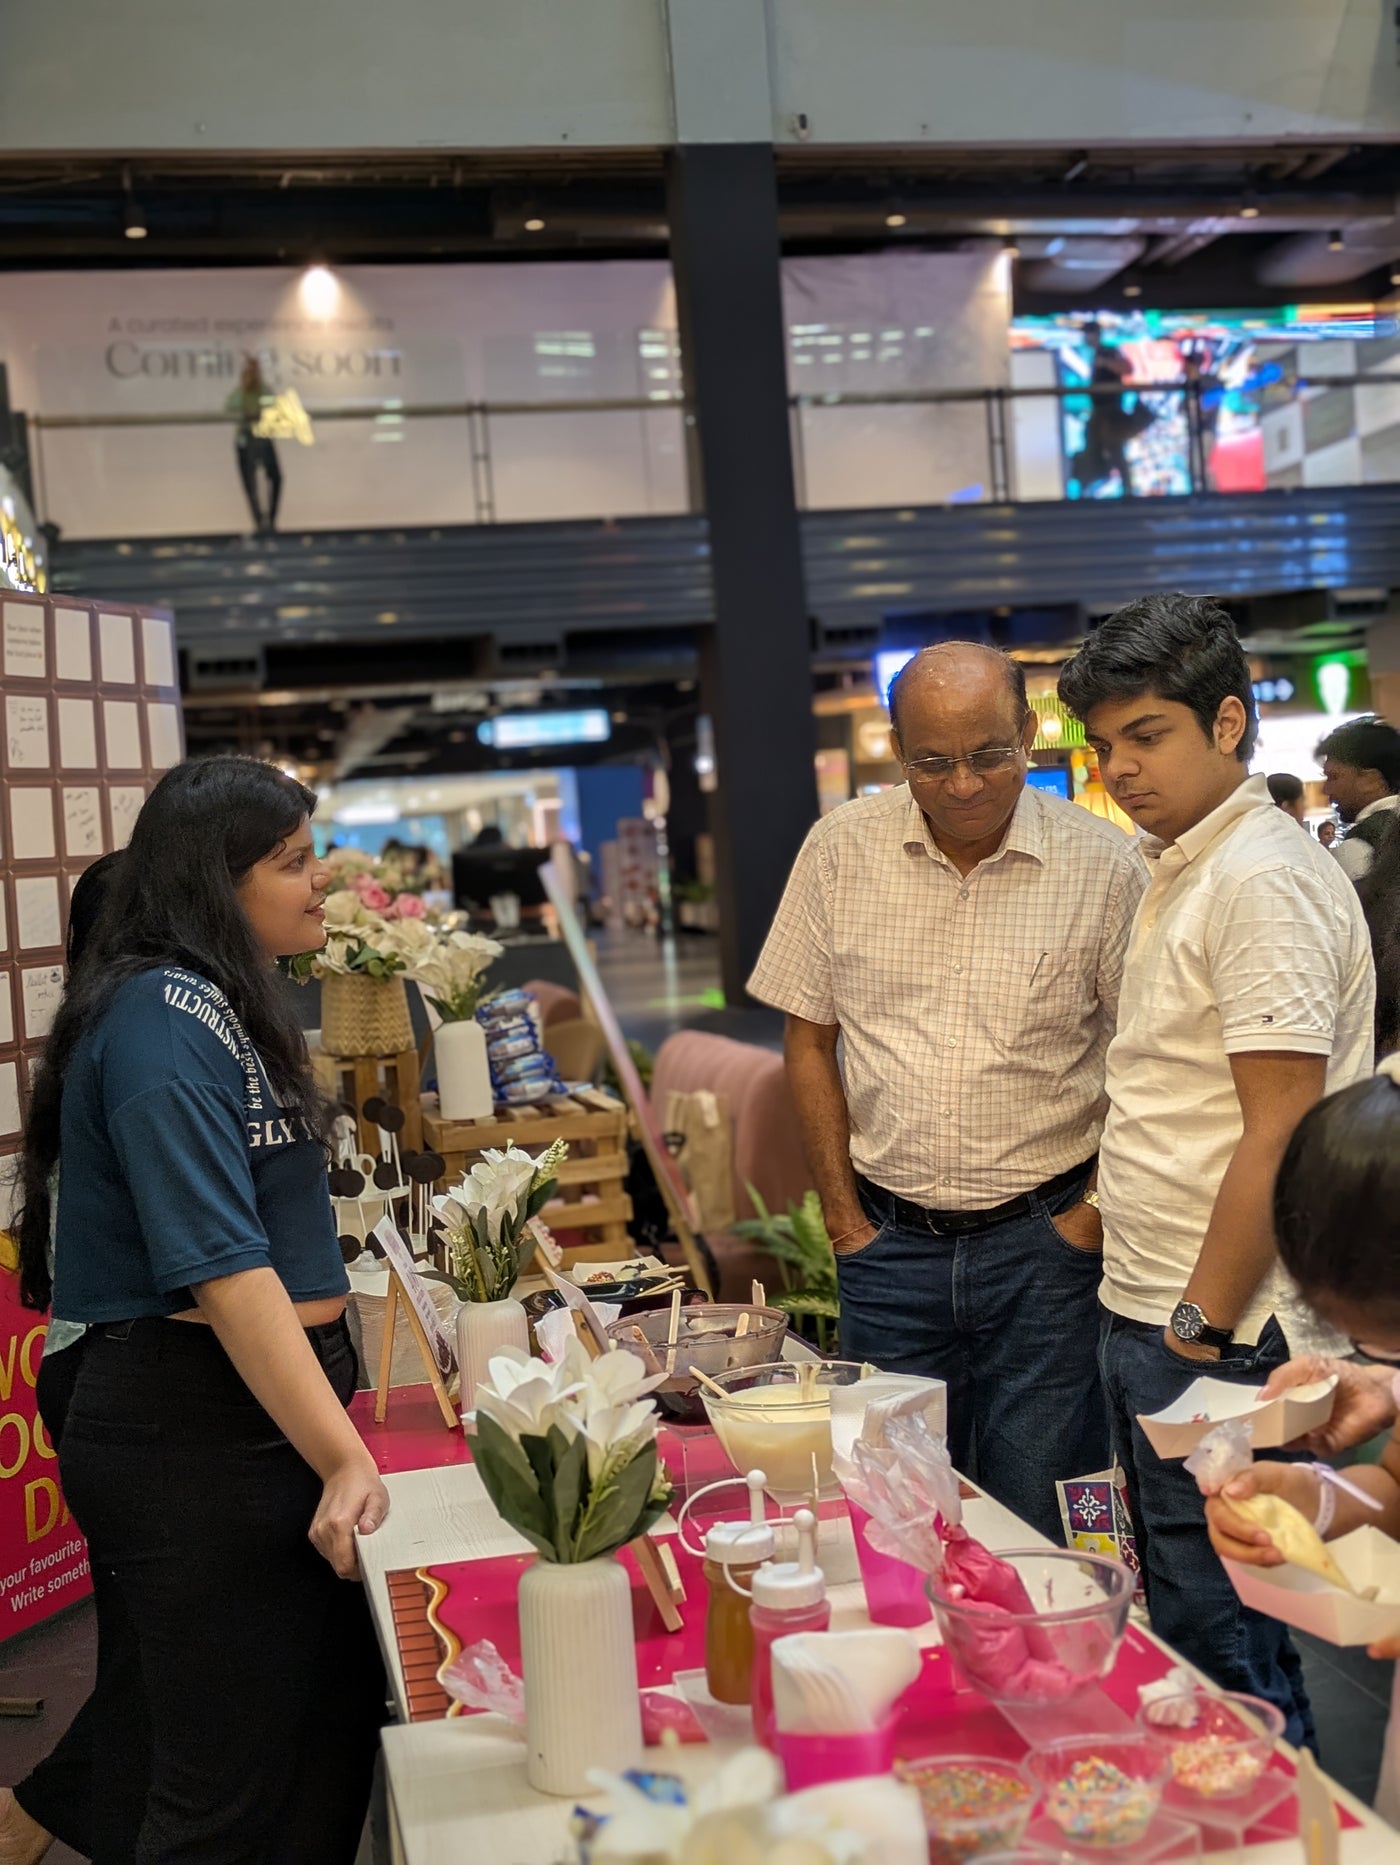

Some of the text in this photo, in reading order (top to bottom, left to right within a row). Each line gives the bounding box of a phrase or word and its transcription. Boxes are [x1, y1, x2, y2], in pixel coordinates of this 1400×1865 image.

[291, 350, 402, 377] soon
[163, 969, 263, 1110] be the best symbols styles wears
[0, 1538, 82, 1597] your favourite
[10, 1585, 45, 1612] Write
